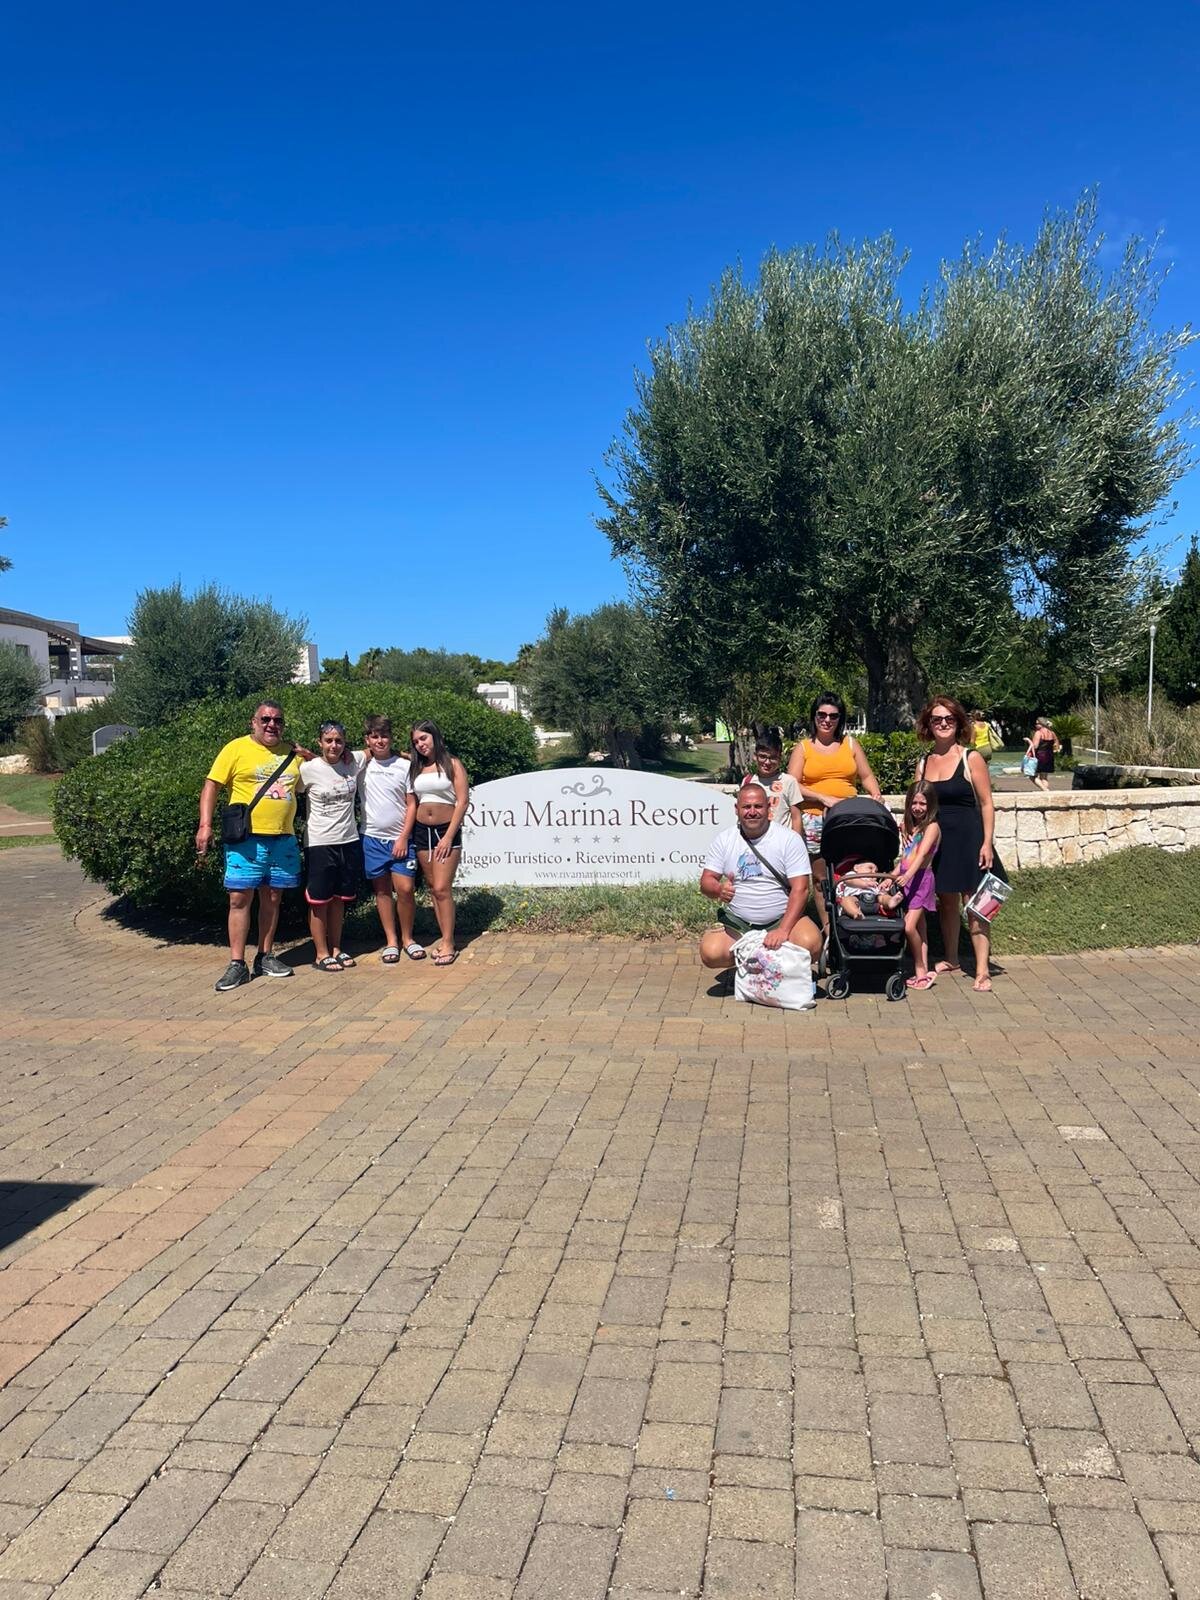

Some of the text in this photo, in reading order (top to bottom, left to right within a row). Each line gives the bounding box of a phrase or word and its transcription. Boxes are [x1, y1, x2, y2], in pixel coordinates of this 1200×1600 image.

[461, 799, 719, 827] Riva Marina Resort
[460, 850, 502, 869] laggio
[503, 851, 563, 865] Turistico
[575, 850, 656, 865] Ricevimenti
[535, 869, 641, 879] www.rivamarinaresort.it
